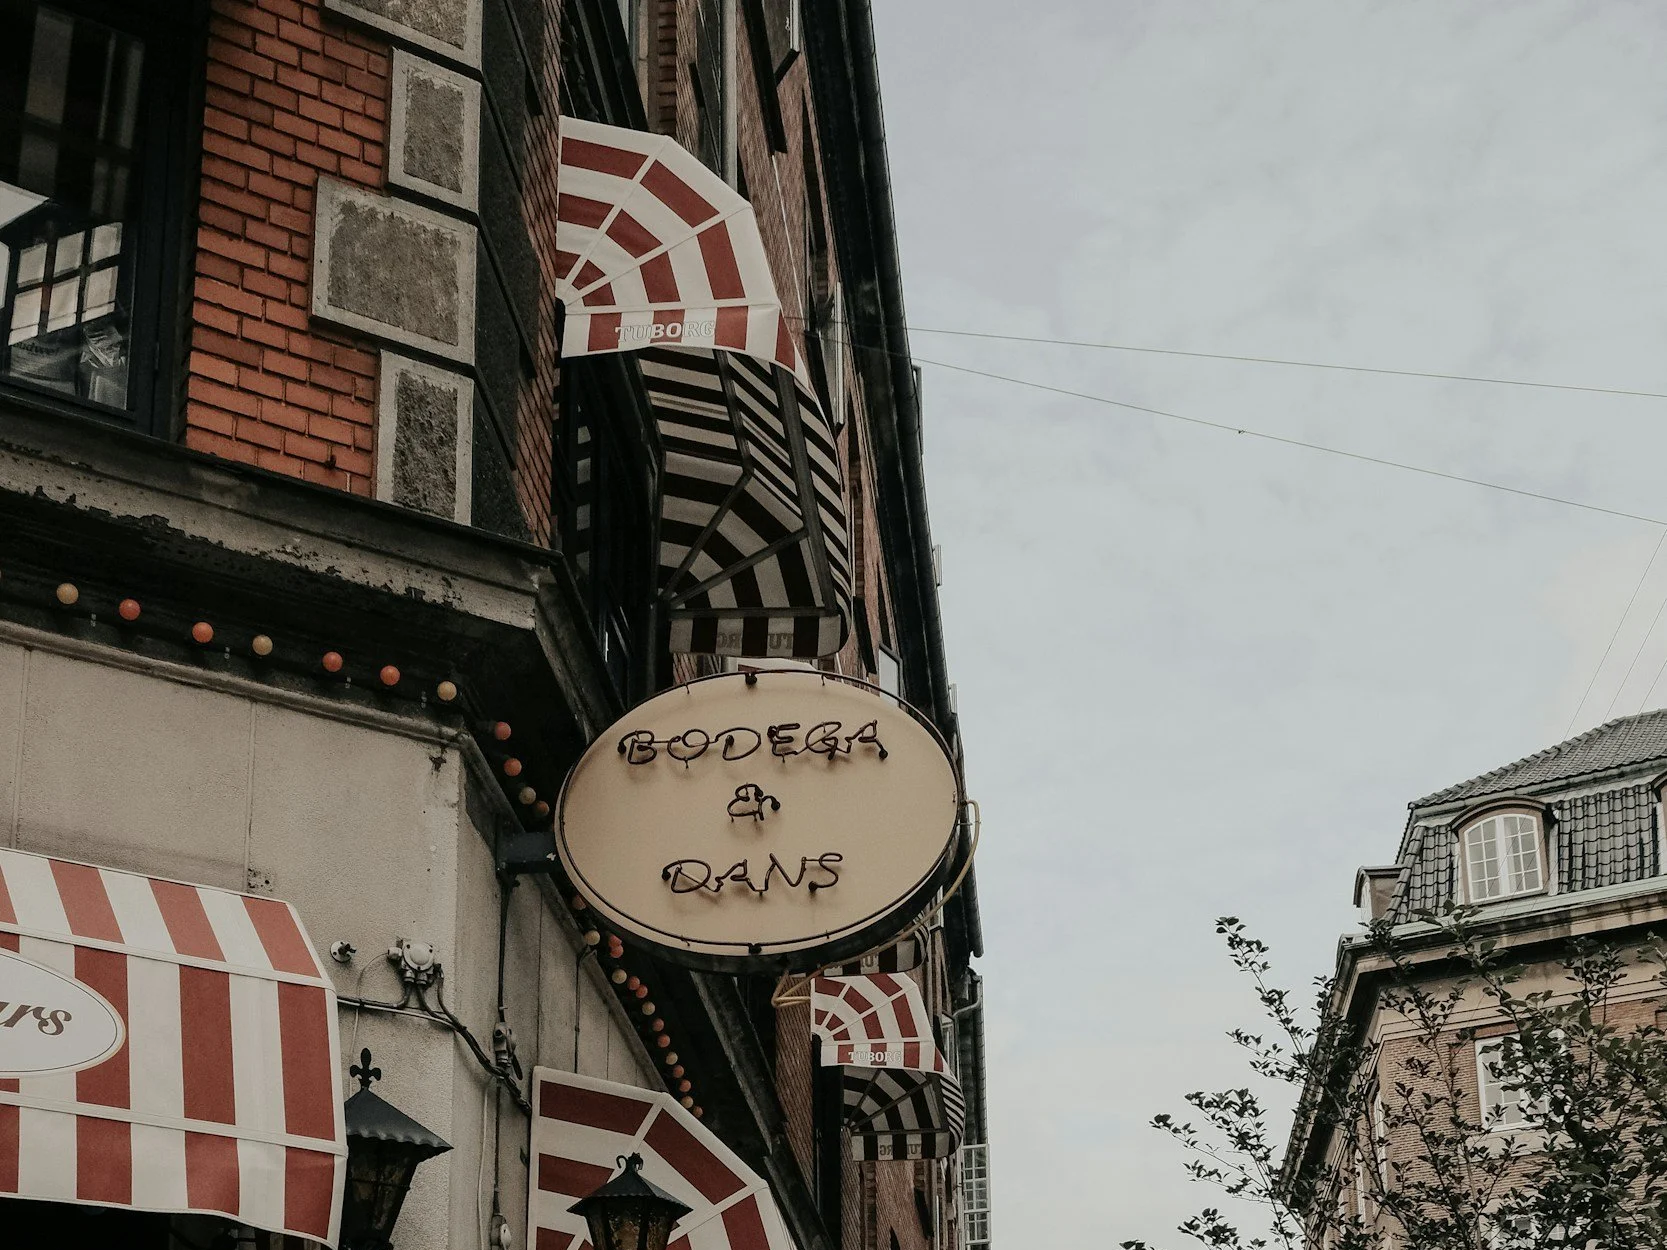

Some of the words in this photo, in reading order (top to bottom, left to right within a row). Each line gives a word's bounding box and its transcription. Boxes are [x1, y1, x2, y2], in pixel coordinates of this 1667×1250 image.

[615, 320, 715, 342] TUBORG
[618, 720, 888, 768] BODEGA
[662, 853, 843, 894] DANS
[848, 1051, 902, 1063] TUBORG
